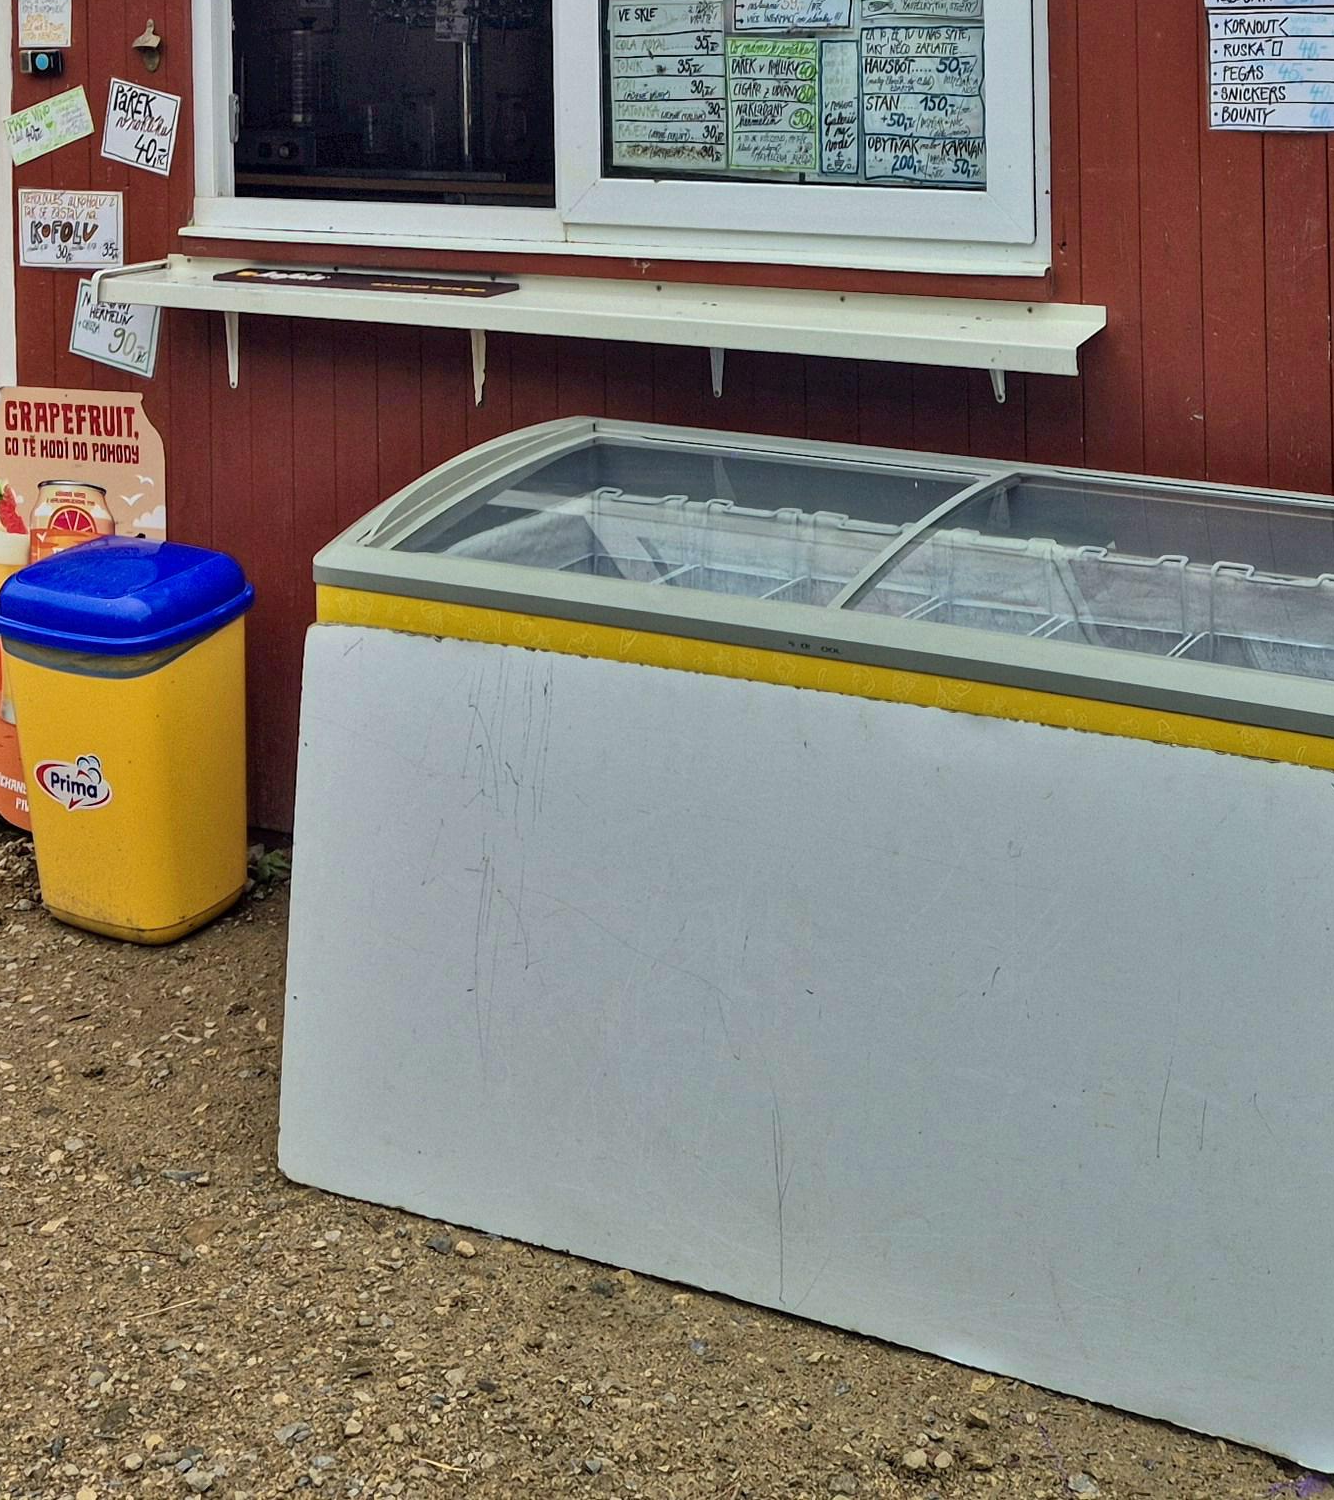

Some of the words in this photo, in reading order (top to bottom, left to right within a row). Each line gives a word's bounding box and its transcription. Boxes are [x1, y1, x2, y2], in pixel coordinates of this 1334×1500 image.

[618, 10, 630, 21] VE
[1223, 18, 1280, 36] KORNOUT
[1223, 64, 1264, 82] PEGAS
[865, 95, 900, 112] STAN
[1221, 85, 1286, 104] SNICKERS
[1222, 106, 1276, 125] BOUNTY
[5, 400, 139, 440] GRAPEFRUIT,
[5, 437, 18, 455] CO
[23, 435, 36, 457] TĚ
[40, 437, 69, 460] HODÍ
[73, 442, 88, 461] DO
[92, 443, 139, 464] POHODY
[51, 771, 97, 798] Prima
